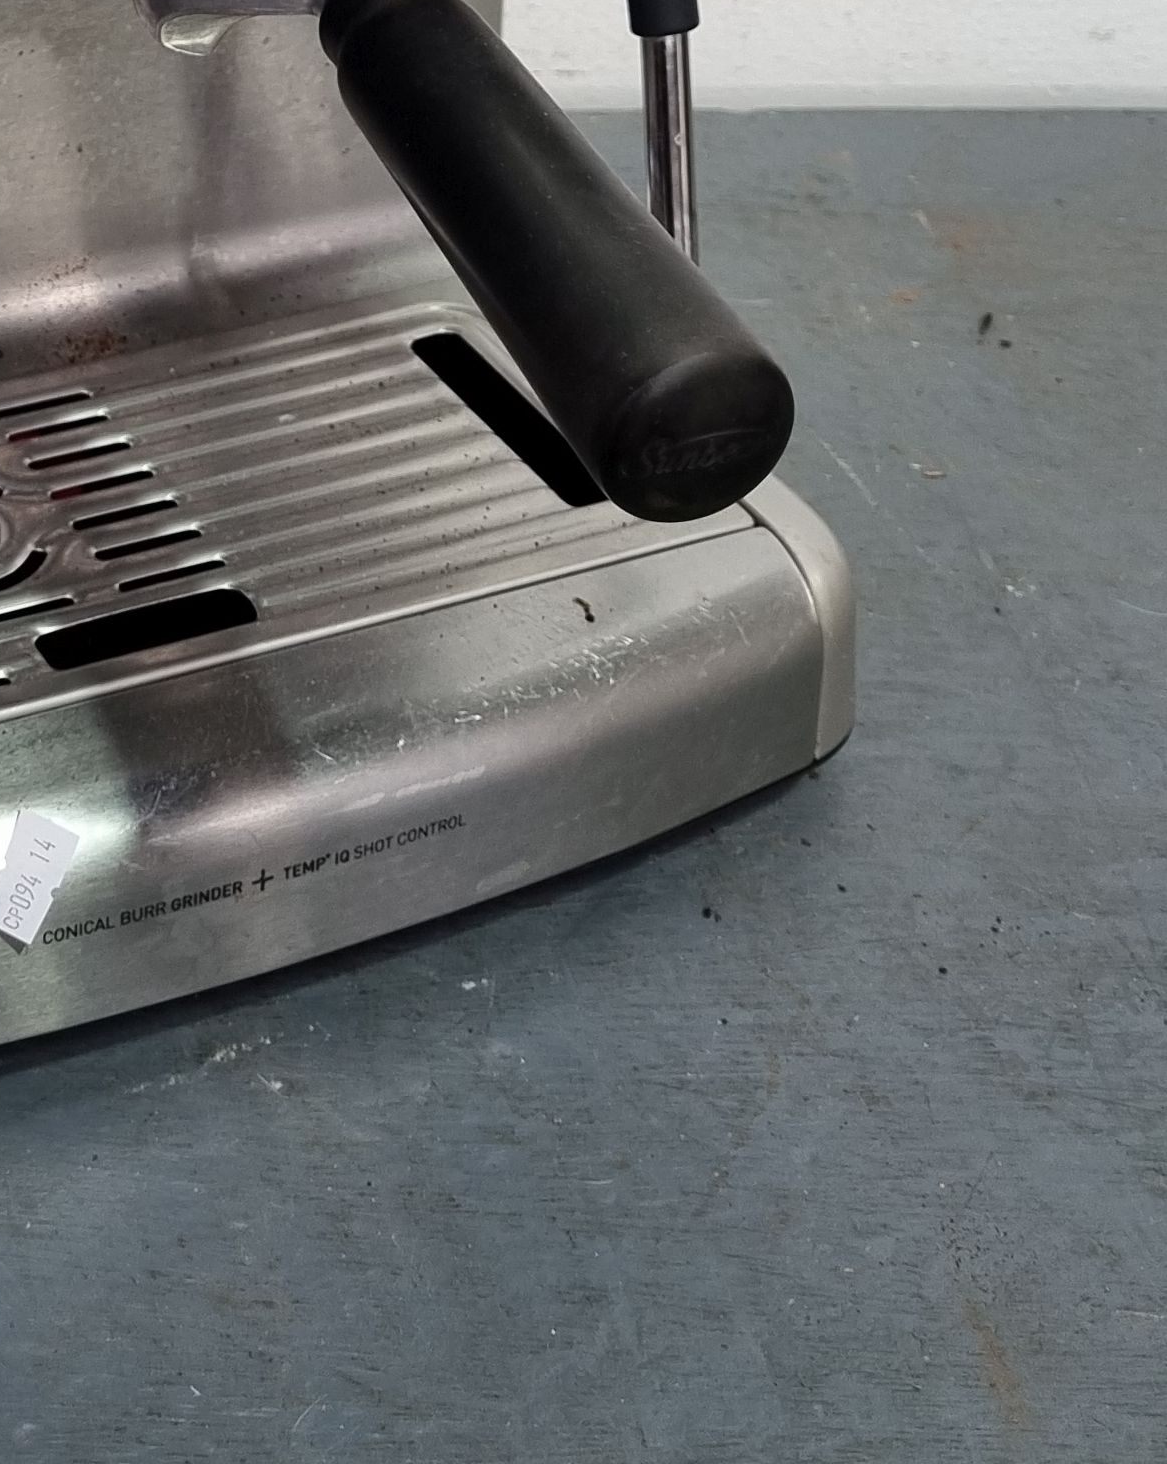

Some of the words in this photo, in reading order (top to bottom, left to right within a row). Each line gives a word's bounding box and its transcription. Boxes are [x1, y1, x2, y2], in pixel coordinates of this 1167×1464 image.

[2, 874, 42, 930] CP094
[29, 837, 56, 863] 14
[43, 916, 116, 945] CONICAL
[120, 901, 167, 927] BURR
[171, 881, 243, 912] GRINDER
[335, 848, 351, 865] IQ
[353, 836, 394, 860] SHOT
[396, 814, 467, 846] CONTROL
